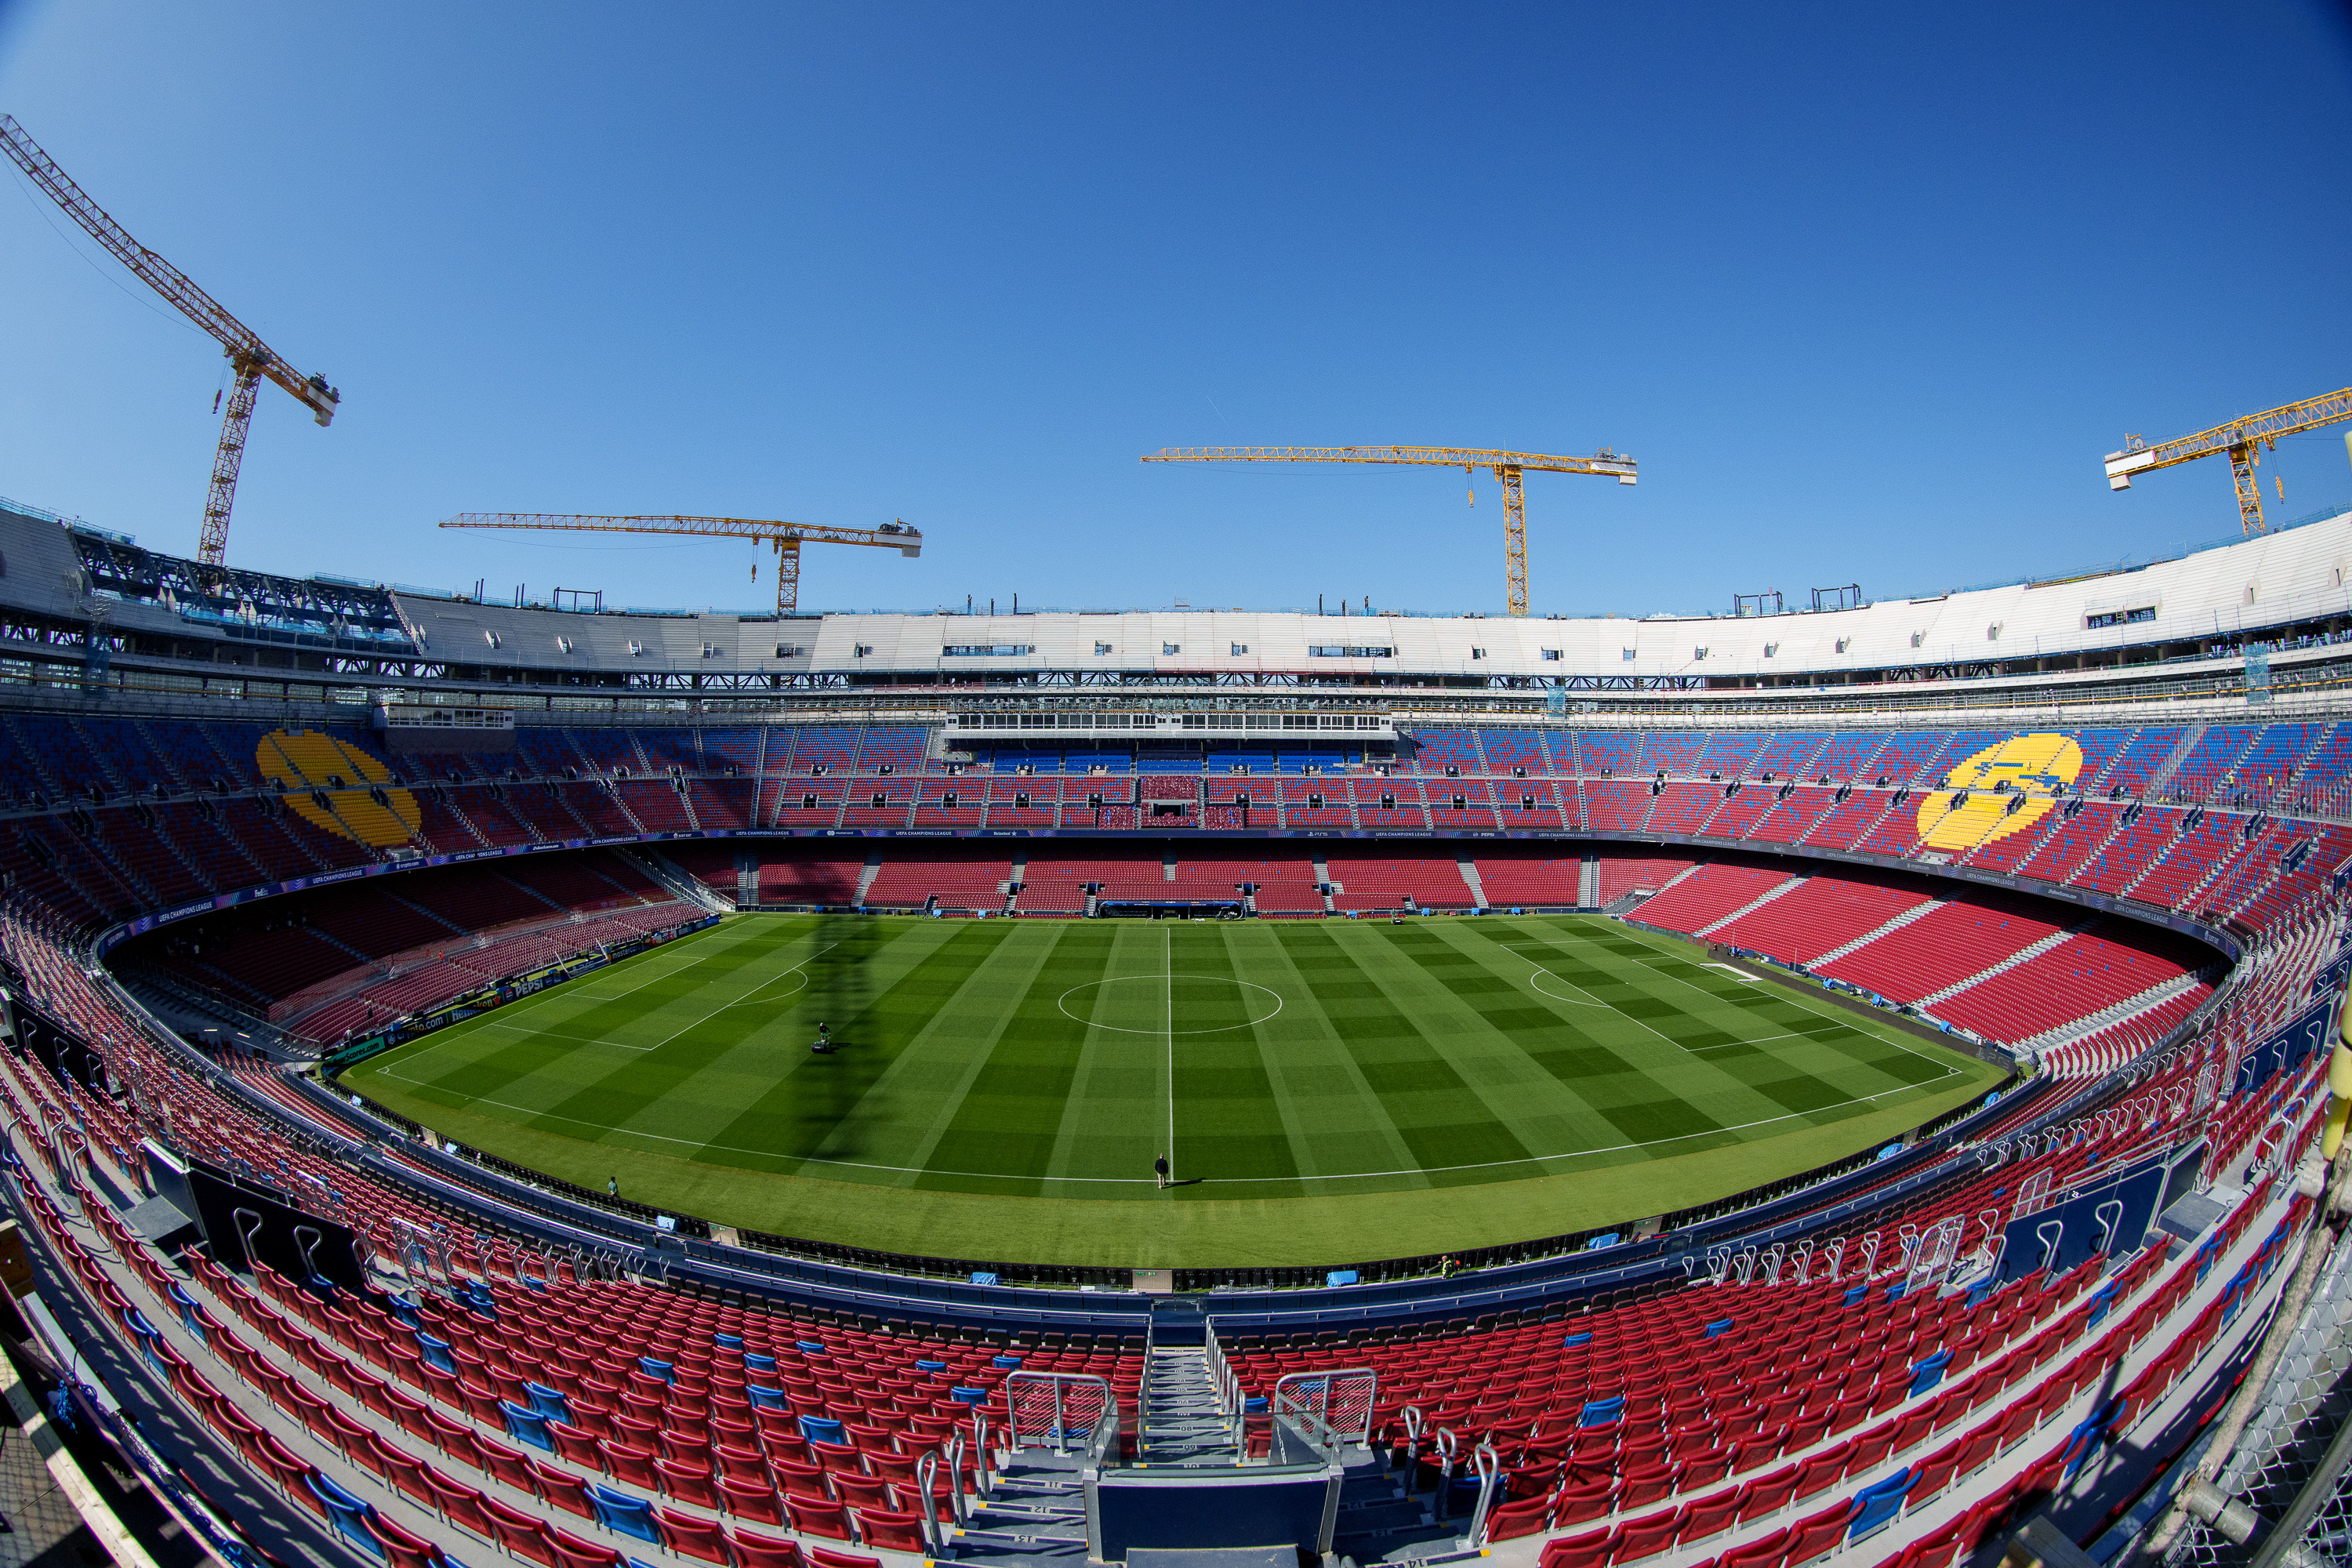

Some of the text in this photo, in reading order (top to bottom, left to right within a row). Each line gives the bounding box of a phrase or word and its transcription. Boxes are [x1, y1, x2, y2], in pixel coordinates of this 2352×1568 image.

[466, 851, 488, 859] CHAIONS
[323, 873, 347, 882] CHAMPIONS
[1976, 874, 2000, 884] CHAMPIONS
[158, 901, 212, 922] UEFA CHAMPIONS LEAGUE
[2114, 903, 2169, 924] UEFA CHAMPIONS LEAGUE
[515, 978, 544, 998] PEPSI
[1034, 1505, 1047, 1514] 12
[1018, 1534, 1033, 1543] 13
[1406, 1558, 1423, 1568] 14
